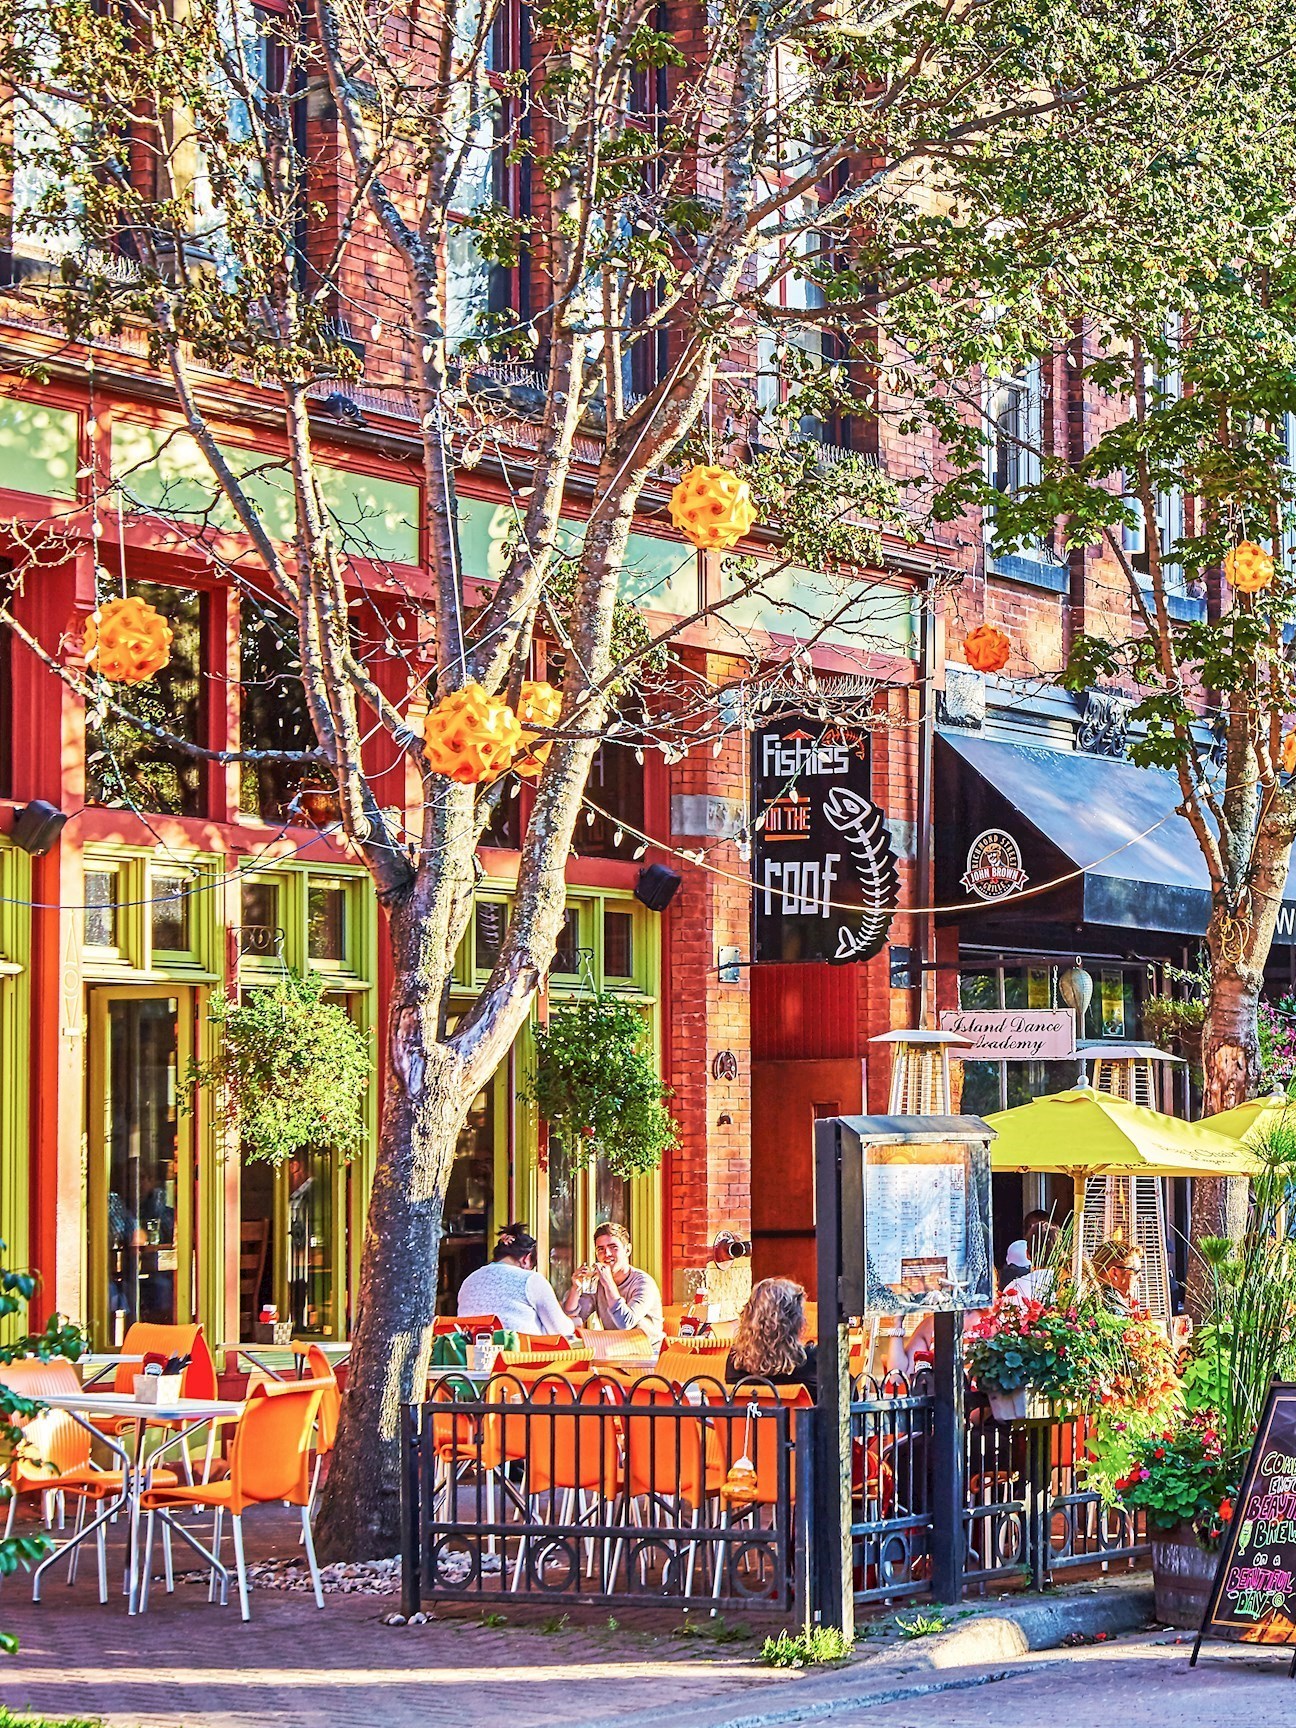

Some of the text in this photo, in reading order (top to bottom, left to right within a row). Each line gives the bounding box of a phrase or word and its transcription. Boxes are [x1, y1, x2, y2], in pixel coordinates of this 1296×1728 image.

[783, 807, 812, 831] THE
[972, 834, 1017, 869] RICHMOND STREET
[970, 867, 1019, 883] JOHN BROWN
[982, 881, 1006, 893] GRILLE
[949, 1016, 1062, 1033] Island Dance
[1234, 1590, 1269, 1621] DAY
